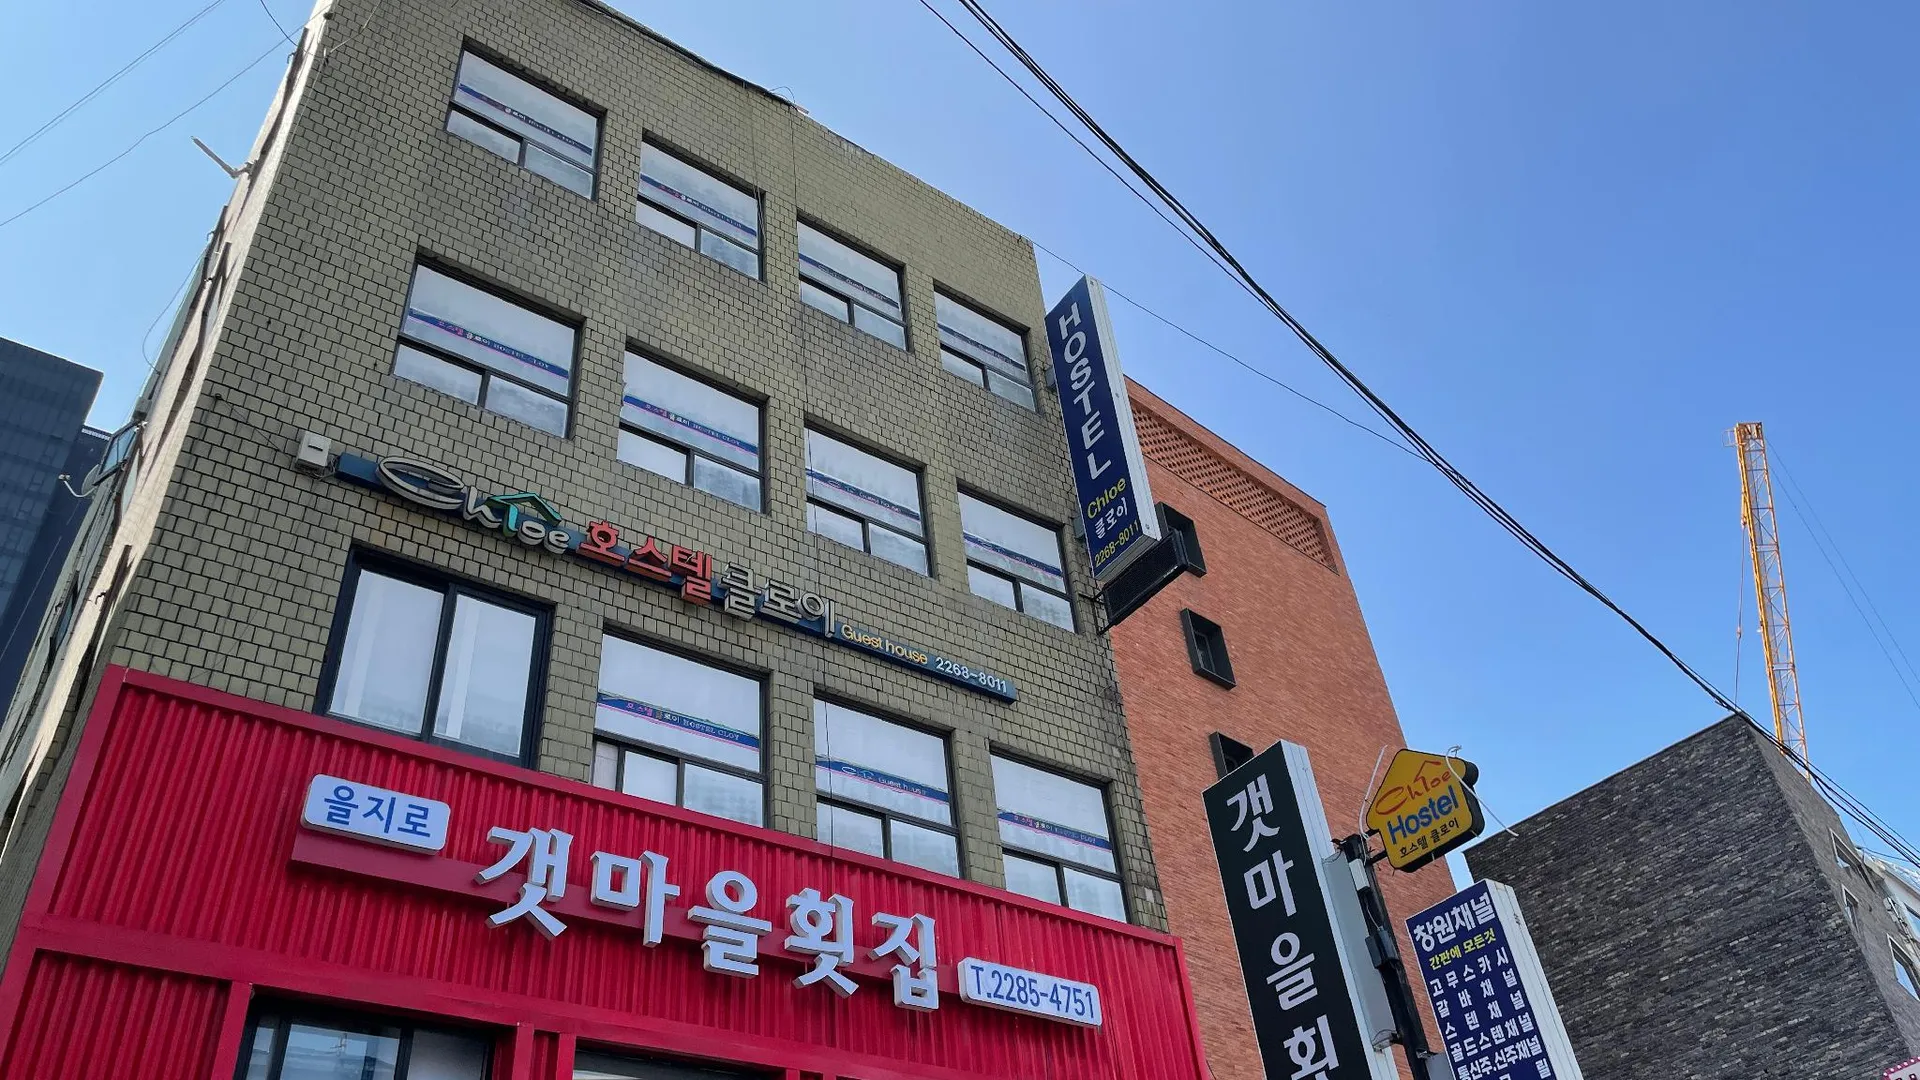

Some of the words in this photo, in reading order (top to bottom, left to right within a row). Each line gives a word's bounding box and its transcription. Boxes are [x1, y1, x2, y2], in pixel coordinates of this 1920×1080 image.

[1058, 302, 1111, 480] HOSTEL
[1087, 478, 1126, 519] Chloe
[1094, 497, 1128, 539] 클로이
[1095, 519, 1139, 568] 2268-8011
[576, 520, 712, 605] 호스텔
[717, 563, 834, 637] 클로이
[841, 625, 883, 651] Guest
[885, 638, 928, 665] house
[935, 656, 1007, 693] 2268-8011
[324, 785, 431, 838] 을지로
[1375, 760, 1451, 815] Chloe
[1387, 784, 1459, 845] Hostel
[1400, 835, 1429, 859] 호스텔
[1430, 817, 1460, 844] 클로이
[474, 826, 940, 1012] 갯마을횟집
[1413, 891, 1496, 952] 창원채널
[1429, 945, 1462, 970] 간판에
[1463, 927, 1496, 953] 모든것
[971, 964, 1095, 1020] T.2285-4751
